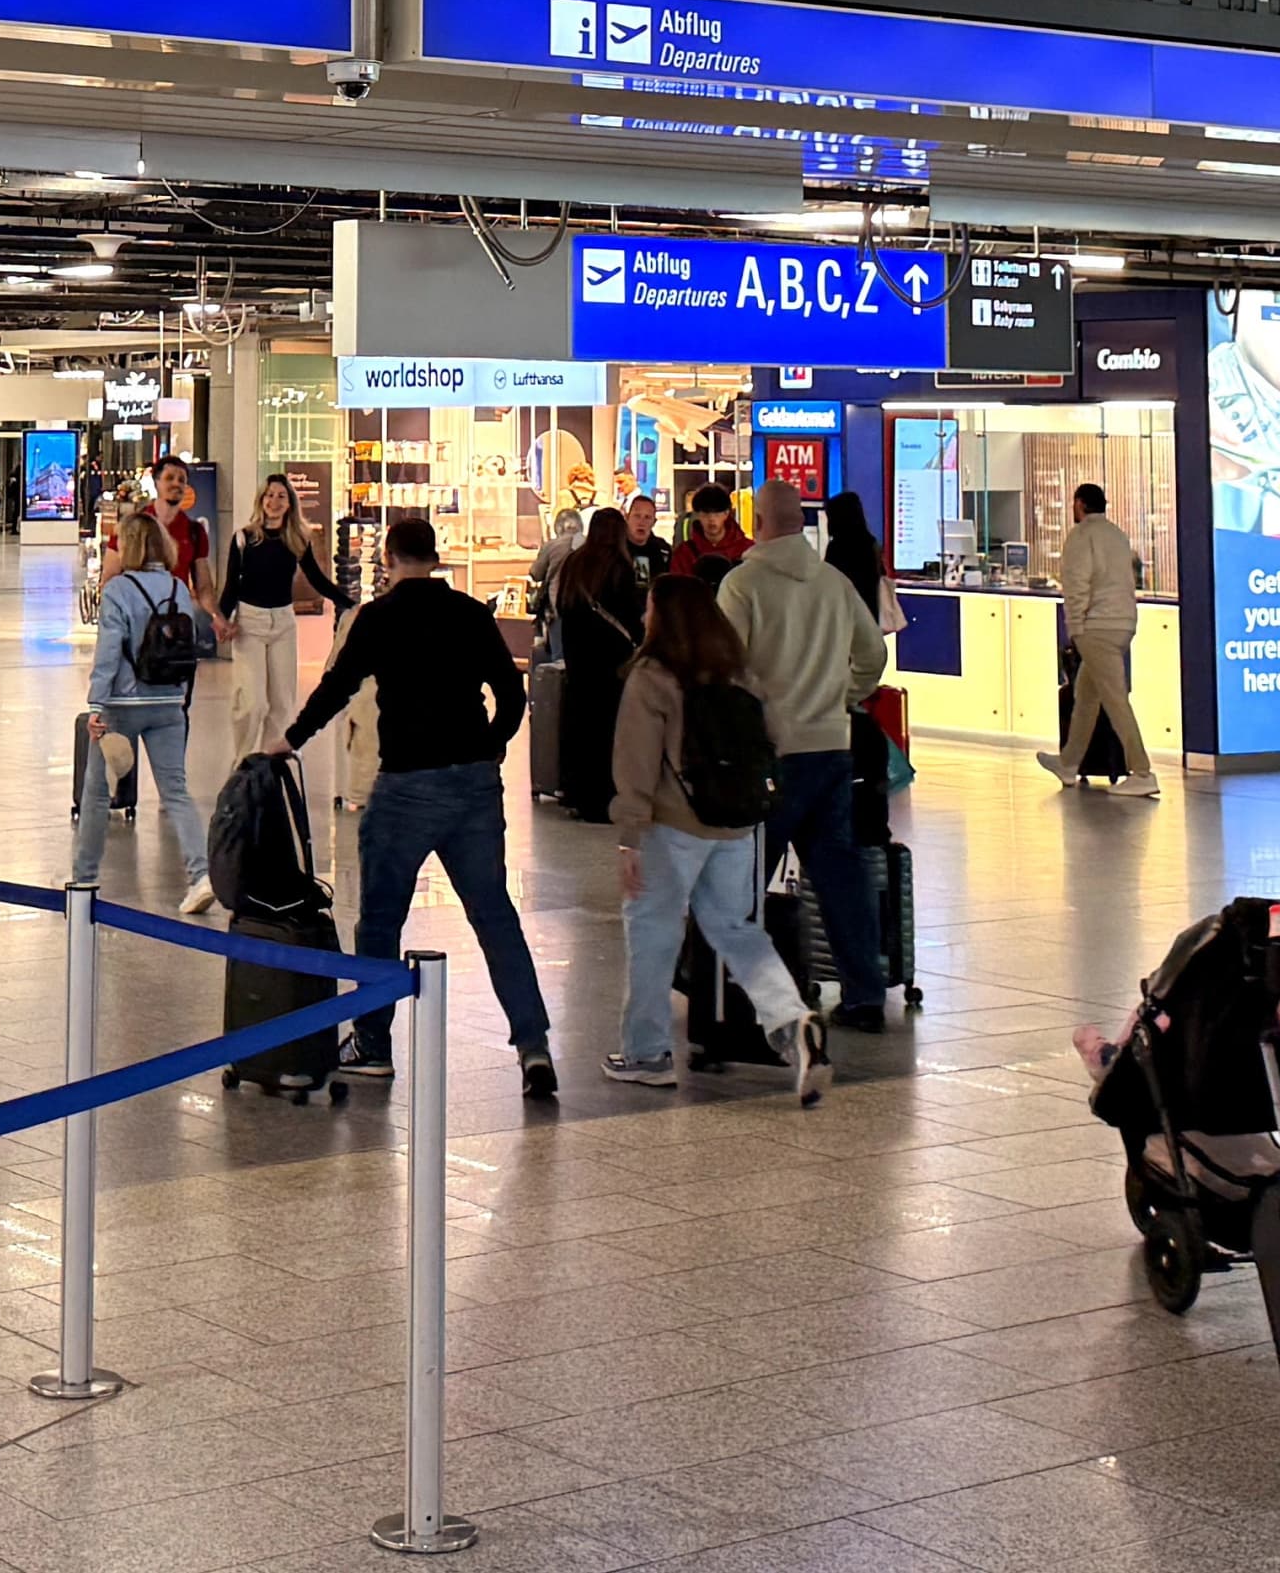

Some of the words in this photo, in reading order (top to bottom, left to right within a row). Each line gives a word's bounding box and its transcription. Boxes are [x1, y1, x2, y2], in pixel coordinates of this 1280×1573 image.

[660, 9, 722, 43] Abflug
[660, 44, 761, 75] Departures
[634, 250, 690, 279] Abflug
[634, 282, 727, 309] Departures
[1097, 349, 1160, 371] Cambio
[366, 362, 464, 392] worldshop
[513, 372, 564, 386] Lufthansa
[775, 444, 814, 465] ATM
